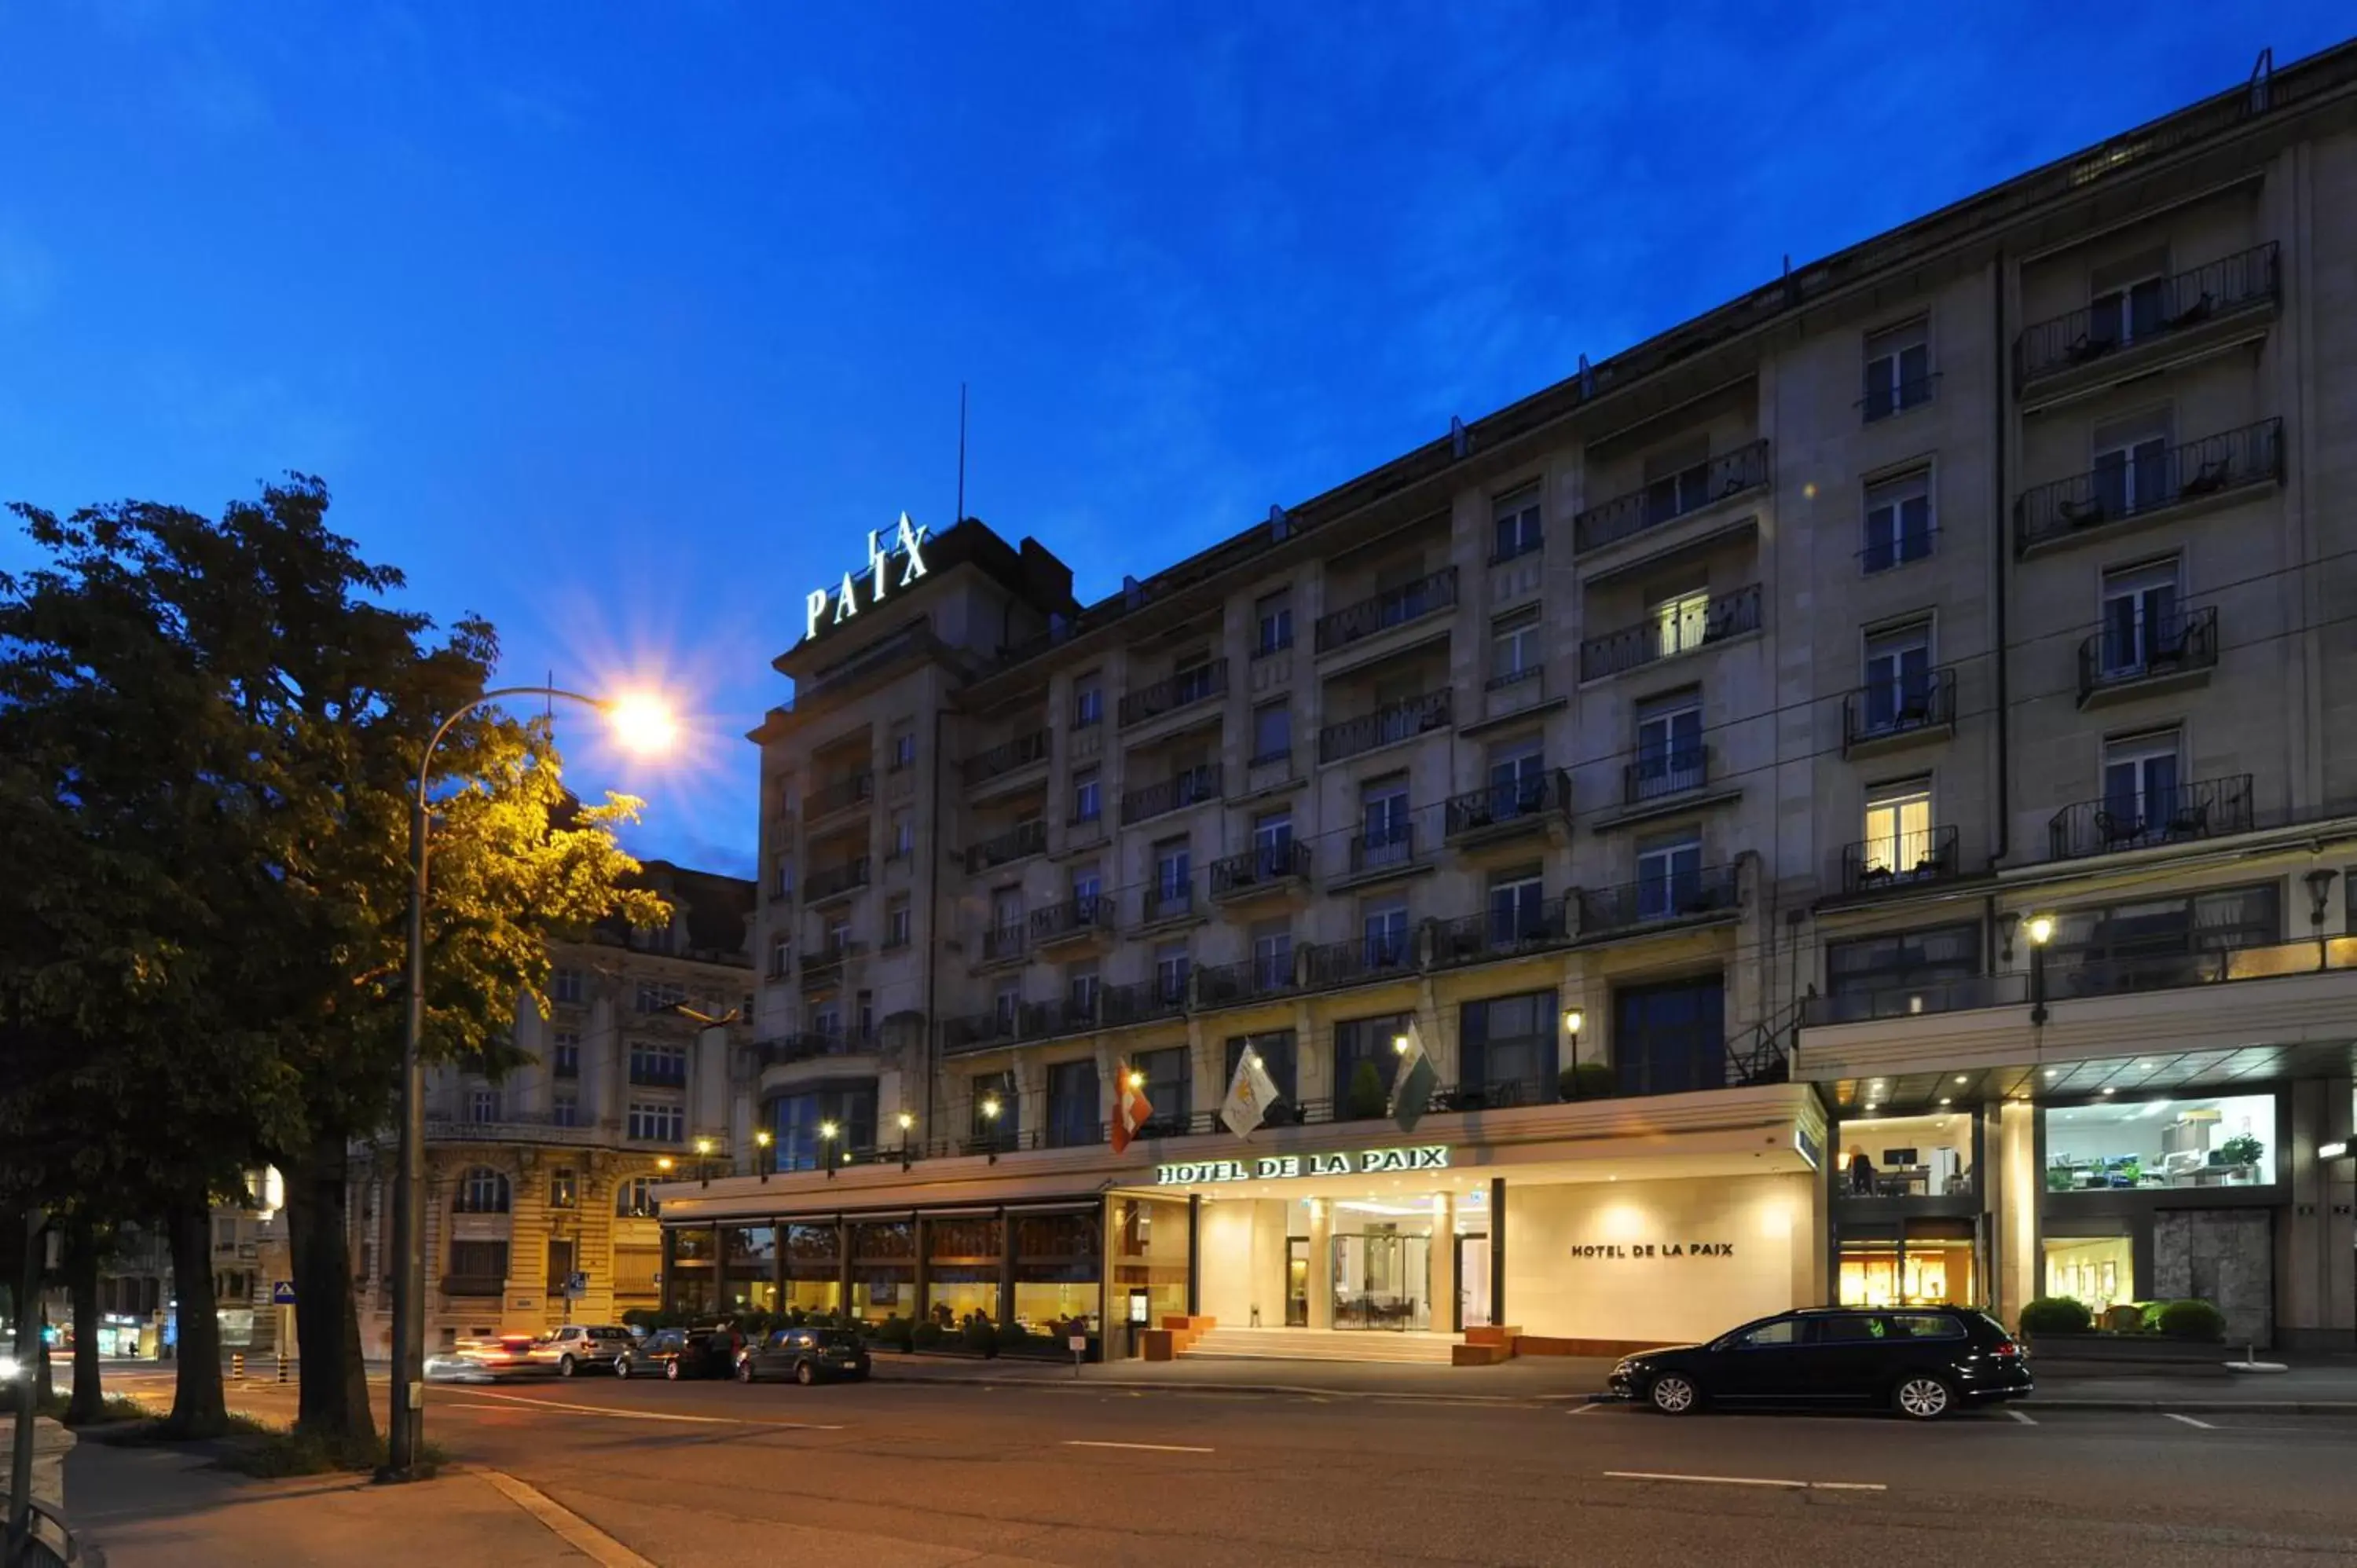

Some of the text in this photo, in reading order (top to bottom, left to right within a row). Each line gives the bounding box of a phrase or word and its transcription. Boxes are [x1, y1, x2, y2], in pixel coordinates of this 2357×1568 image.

[805, 524, 928, 641] PAIX
[1157, 1146, 1447, 1185] HOTEL DE LA PAIX
[1571, 1244, 1734, 1258] HOTEL DE LA PAIX
